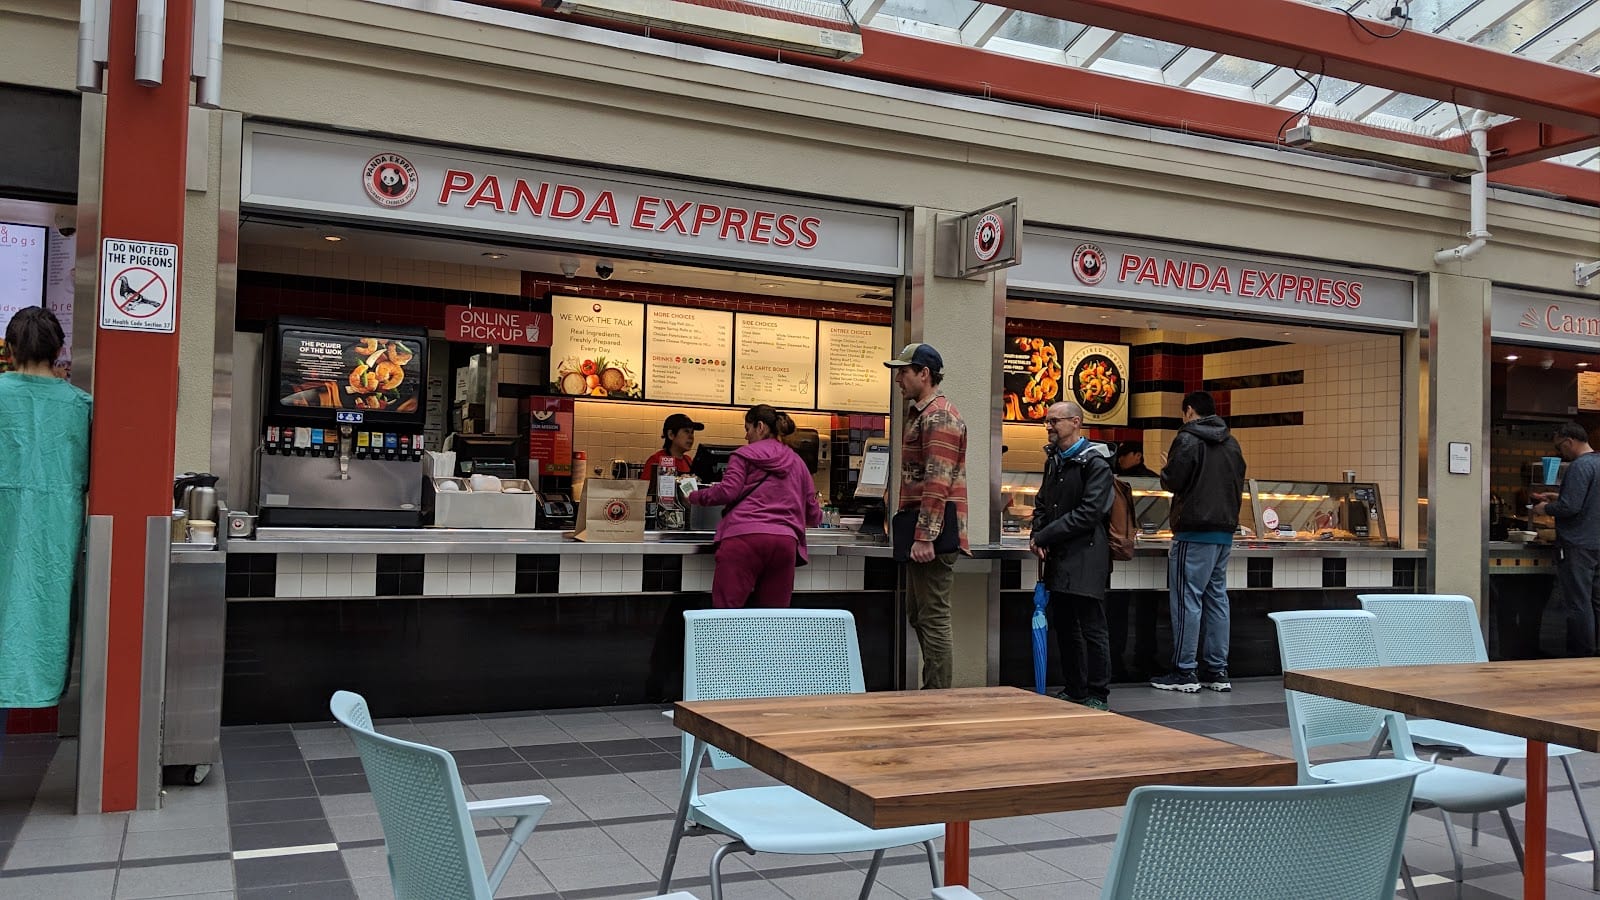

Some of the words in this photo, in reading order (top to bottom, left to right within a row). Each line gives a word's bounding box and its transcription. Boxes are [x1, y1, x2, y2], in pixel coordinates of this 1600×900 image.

[366, 156, 387, 177] PANDA
[390, 156, 416, 182] EXPRESS
[438, 168, 621, 227] PANDA
[630, 195, 822, 250] EXPRESS
[2, 231, 36, 248] dogs
[113, 243, 126, 252] DO
[128, 244, 146, 254] NOT
[150, 246, 169, 256] FEED
[108, 252, 126, 264] THE
[130, 255, 173, 268] PIGEONS
[1118, 253, 1233, 295] PANDA
[1239, 268, 1364, 309] EXPRESS
[144, 320, 162, 328] Section
[460, 310, 520, 328] ONLINE
[560, 313, 573, 321] WE
[574, 314, 594, 322] WOK
[596, 316, 612, 324] THE
[614, 318, 633, 326] TALK
[570, 336, 592, 344] Freshly
[325, 348, 342, 356] WOK
[580, 345, 597, 353] Every
